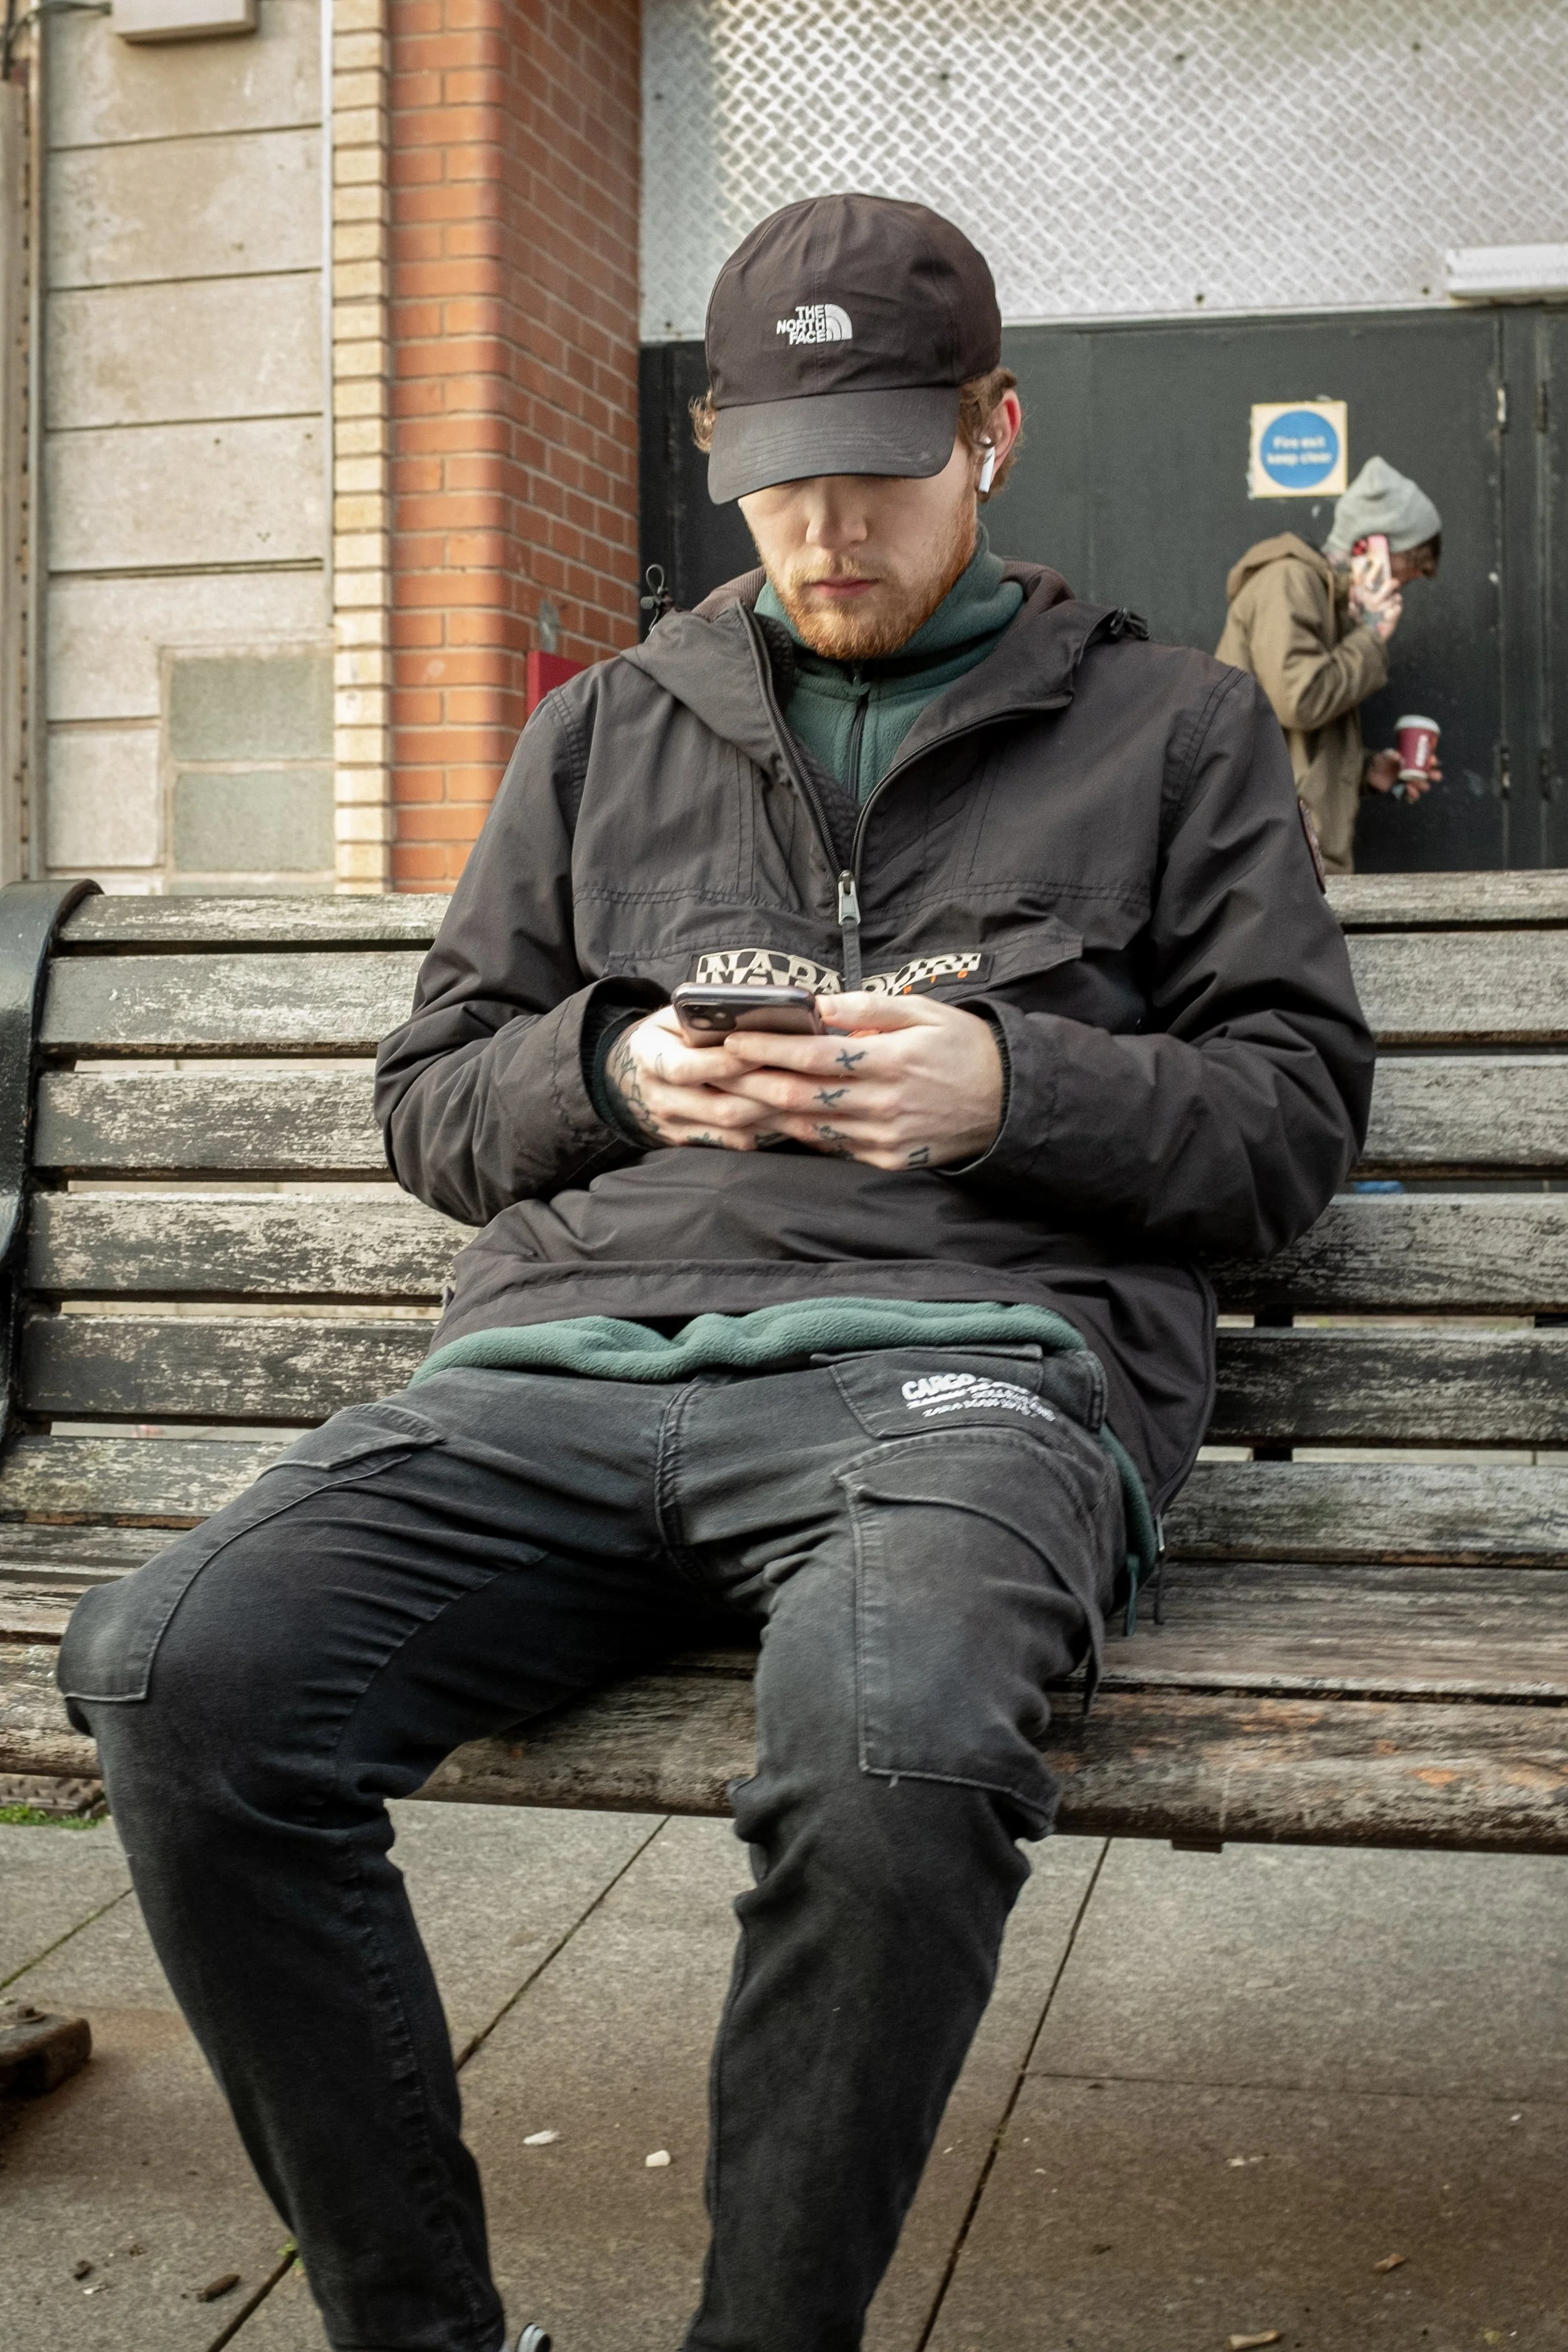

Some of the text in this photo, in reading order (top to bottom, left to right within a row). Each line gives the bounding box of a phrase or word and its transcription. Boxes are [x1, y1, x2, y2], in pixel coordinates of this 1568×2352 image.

[795, 304, 824, 319] THE
[776, 317, 825, 335] NORTH
[789, 330, 827, 346] FACE
[901, 1372, 977, 1401] CARGO
